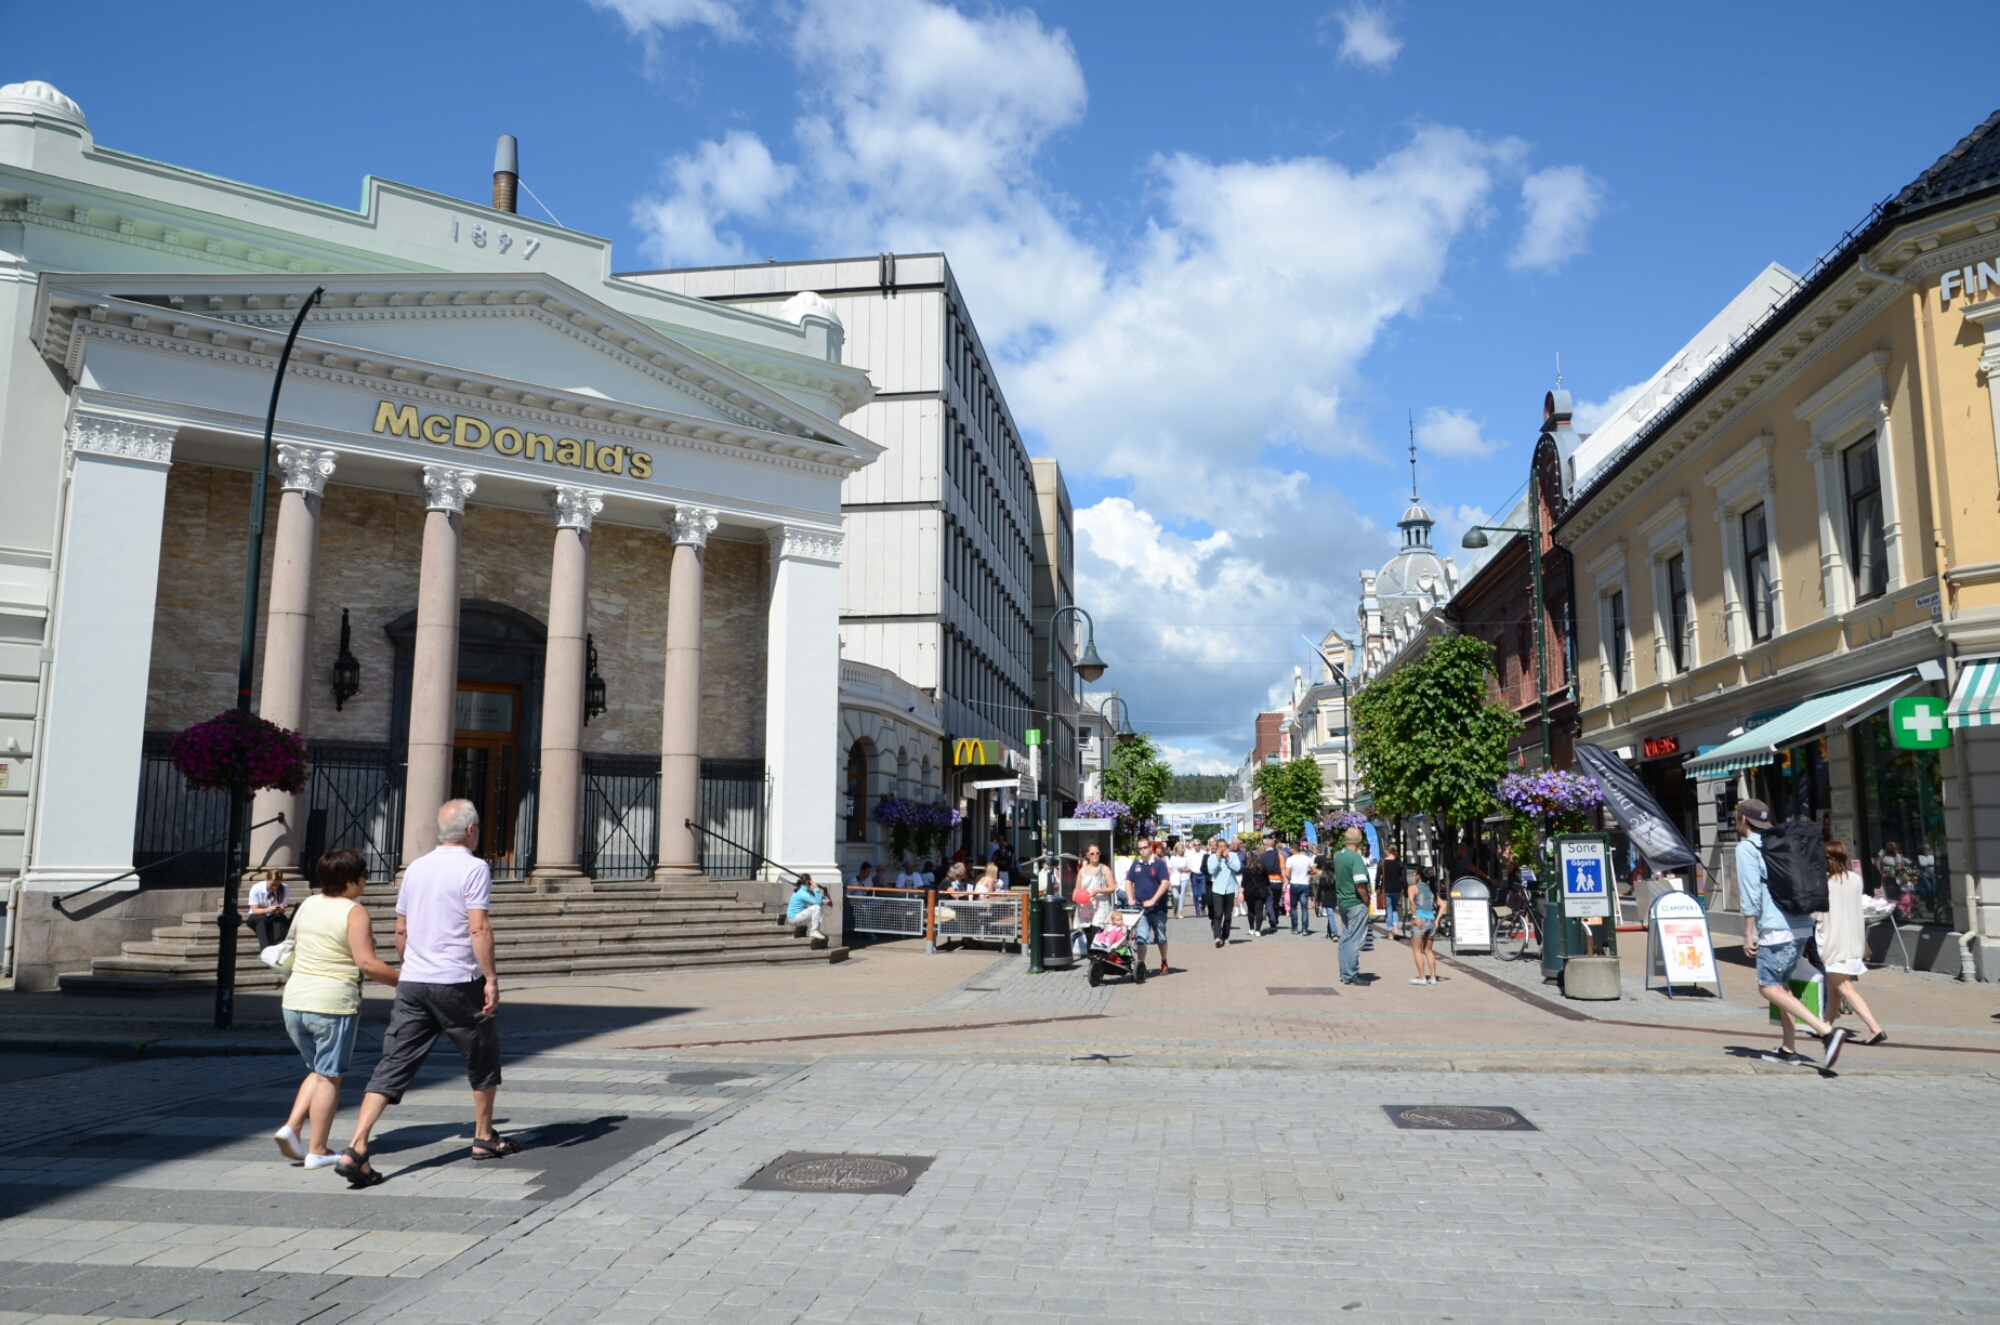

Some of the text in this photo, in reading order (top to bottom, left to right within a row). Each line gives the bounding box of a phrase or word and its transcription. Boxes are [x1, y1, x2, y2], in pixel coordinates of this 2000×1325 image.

[451, 213, 540, 258] 1897
[372, 400, 654, 480] McDonald's
[1567, 842, 1598, 854] Sone
[1570, 859, 1596, 868] Gågate
